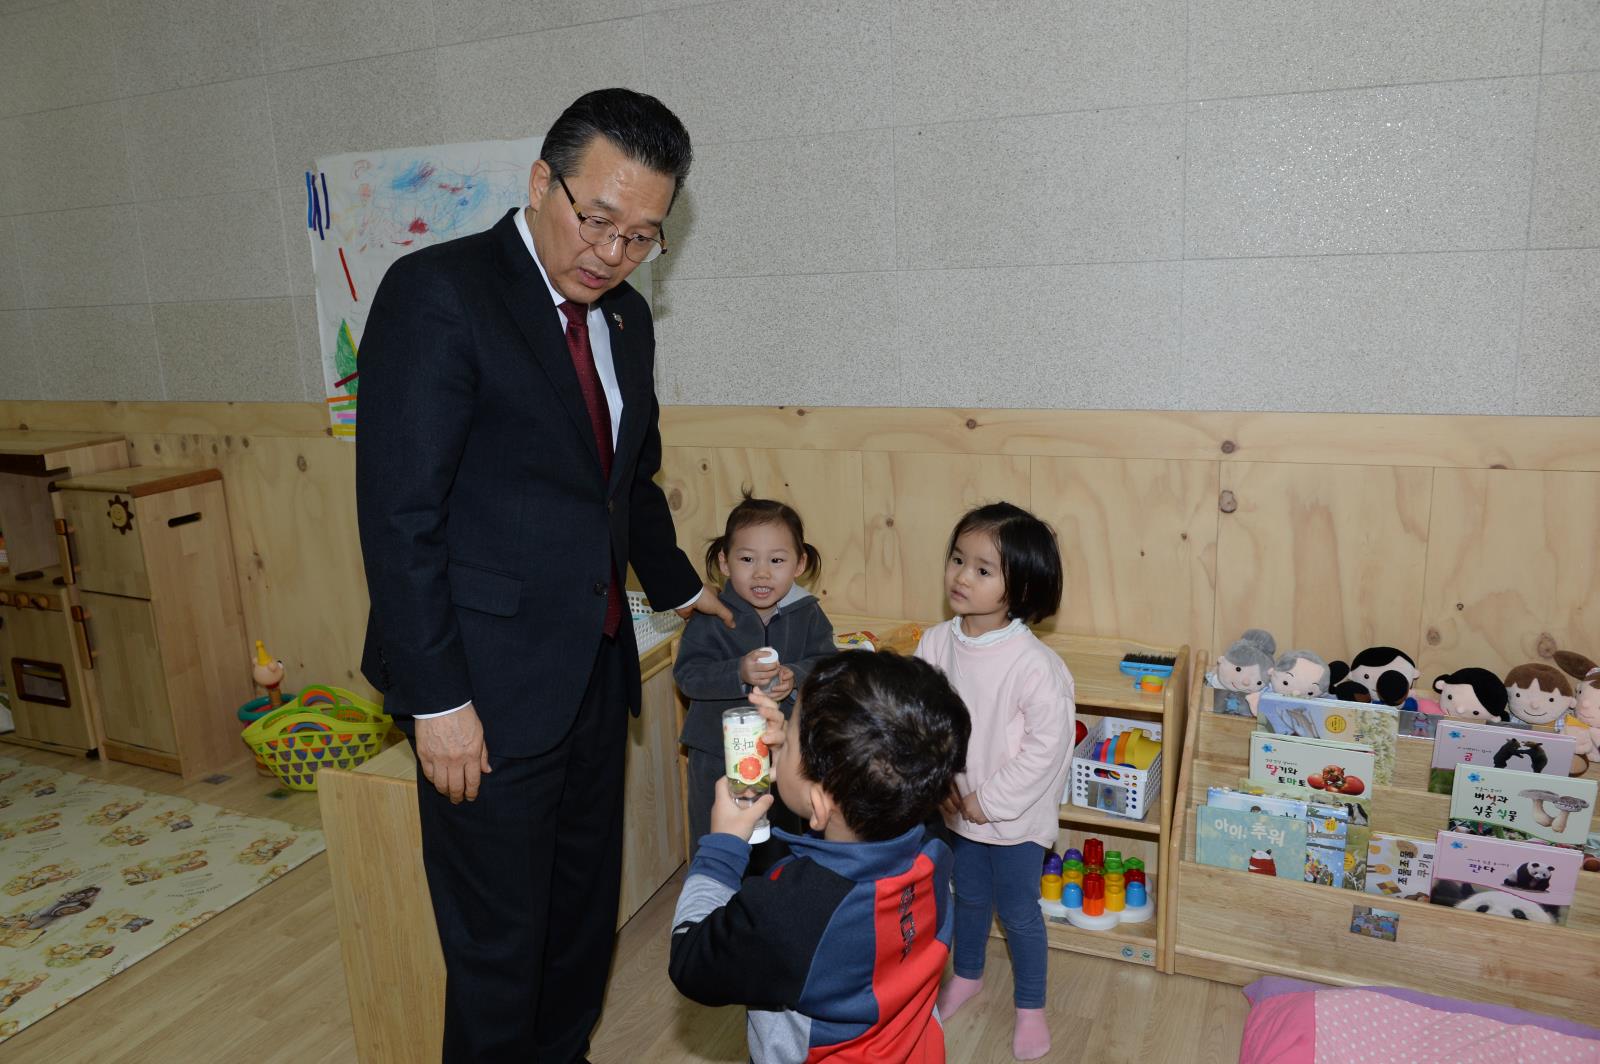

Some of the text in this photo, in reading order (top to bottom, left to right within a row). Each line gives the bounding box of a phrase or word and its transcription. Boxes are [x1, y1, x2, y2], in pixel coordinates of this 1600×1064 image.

[1464, 752, 1473, 762] 곰
[1266, 764, 1298, 776] 딸기와
[1278, 776, 1307, 787] 토마토
[1474, 792, 1509, 806] 버섯과
[1473, 805, 1517, 822] 식충 식물
[1250, 822, 1286, 848] 추워
[1397, 851, 1415, 886] 조물조물
[1469, 863, 1496, 874] 판다
